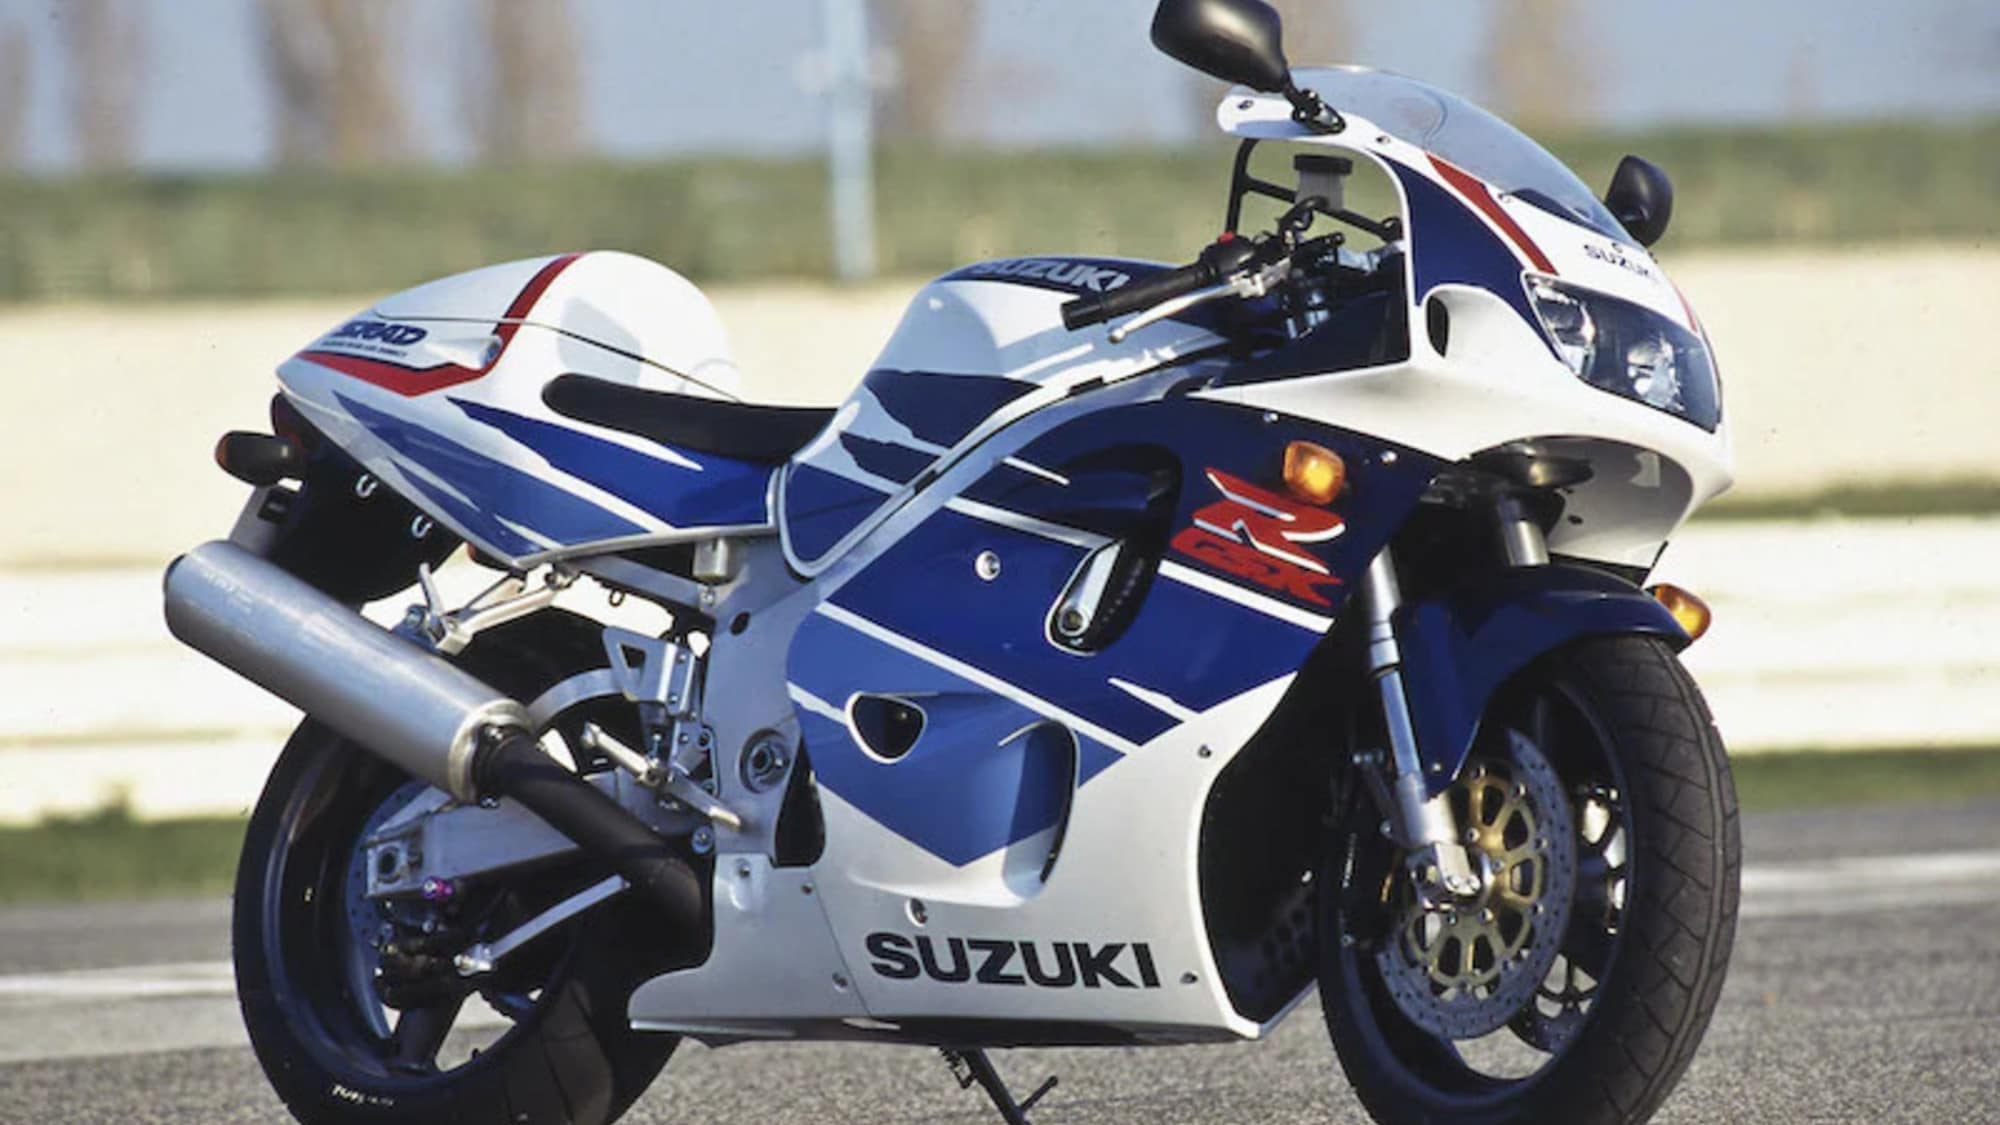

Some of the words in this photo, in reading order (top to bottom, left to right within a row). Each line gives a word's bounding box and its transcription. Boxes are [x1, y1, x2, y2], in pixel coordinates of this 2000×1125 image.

[970, 259, 1130, 292] SUZUKI
[1583, 244, 1658, 282] SUZUK
[1192, 467, 1346, 575] R
[1169, 527, 1344, 608] GSX
[866, 932, 1161, 988] SUZUKI
